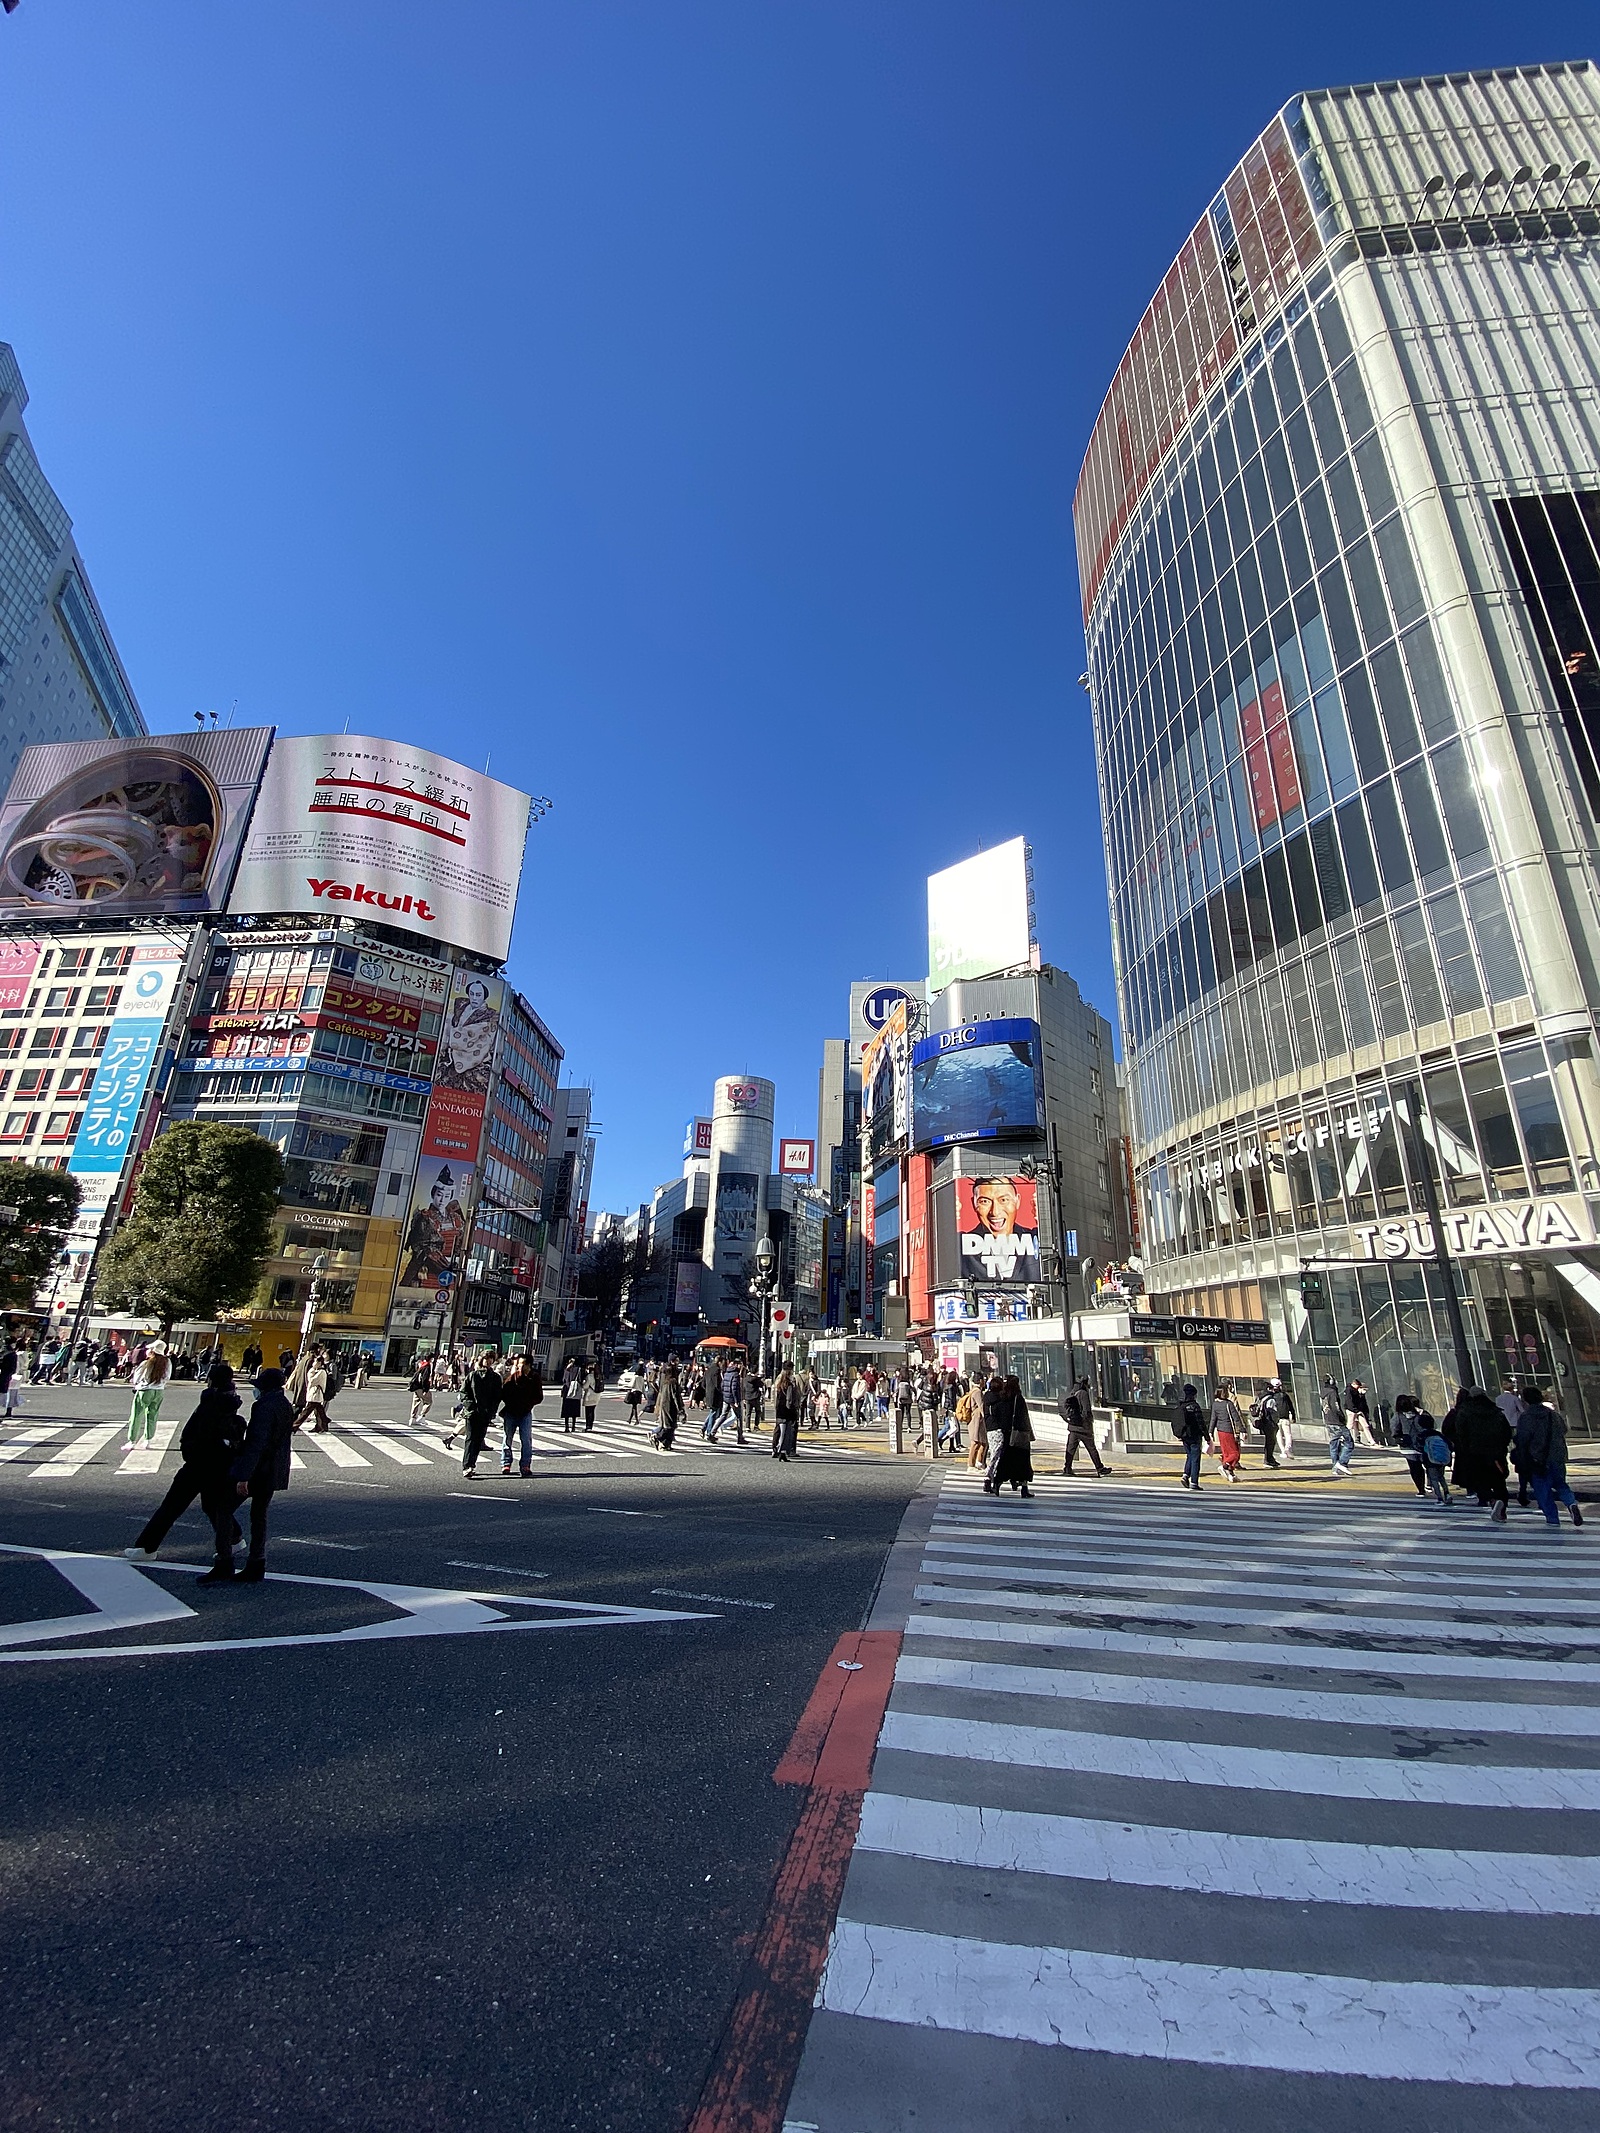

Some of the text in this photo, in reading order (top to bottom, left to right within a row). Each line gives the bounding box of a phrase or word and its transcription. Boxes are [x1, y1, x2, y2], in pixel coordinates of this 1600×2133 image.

[322, 767, 469, 813] ストレス緩和
[313, 791, 463, 835] 睡眠の質向上
[307, 878, 436, 921] Yakult
[214, 956, 230, 967] 9F
[353, 935, 448, 970] しゃぶしゃぶバイキング
[389, 967, 445, 994] しゃぶ葉
[123, 999, 164, 1013] eyecity
[324, 990, 417, 1025] コンタクト
[260, 1014, 301, 1031] ガスト
[190, 1040, 209, 1052] 7F
[384, 1031, 427, 1052] ガスト
[939, 1027, 977, 1049] DHC
[212, 1058, 284, 1070] 英会話イーオン
[313, 1061, 430, 1092] AEON 英会話イーオン
[86, 1037, 131, 1147] アイシティ
[106, 1037, 152, 1147] コンタクトの
[726, 1083, 760, 1109] 109
[430, 1100, 483, 1118] SANEMORI
[944, 1130, 979, 1142] DHC Channel
[788, 1150, 806, 1162] H&M
[79, 1178, 107, 1186] ONTACT
[294, 1213, 350, 1227] L'OCCITANE
[1354, 1202, 1577, 1259] TSUTAYA
[961, 1233, 1035, 1256] DMM
[981, 1255, 1018, 1280] TV
[509, 1289, 526, 1305] LUSH
